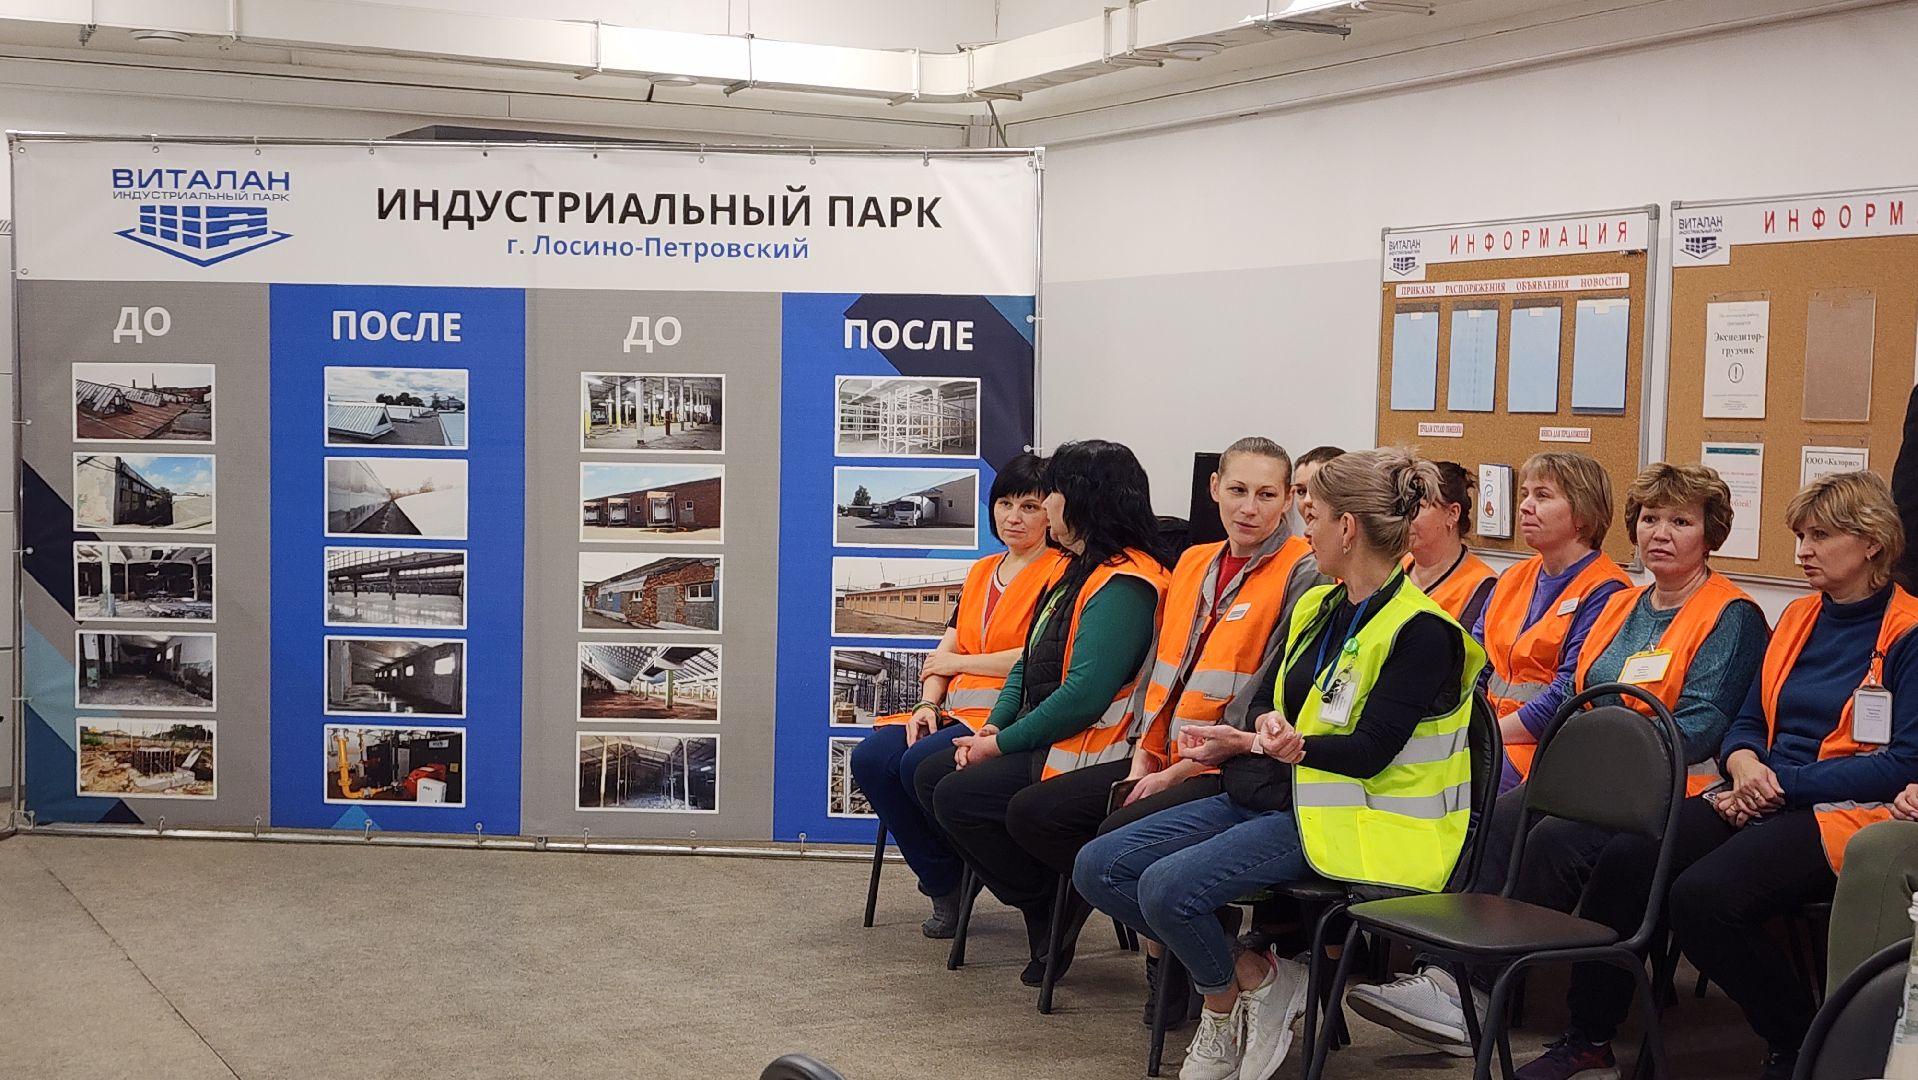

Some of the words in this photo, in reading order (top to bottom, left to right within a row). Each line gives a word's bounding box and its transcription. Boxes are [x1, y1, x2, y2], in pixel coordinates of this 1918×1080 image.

[112, 168, 290, 191] ВИТАЛАН
[112, 190, 248, 201] ИНДУСТРИАЛЬНЫЙ
[252, 193, 290, 202] ПАРК
[376, 185, 811, 230] ИНДУСТРИАЛЬНЫЙ
[828, 196, 942, 228] ПАРК
[1679, 216, 1723, 230] ВИТАЛАН
[1764, 201, 1918, 234] ИНФОРМ
[507, 237, 525, 256] г.
[532, 235, 809, 263] Лосино-Петровский
[1389, 239, 1421, 251] ВИТАЛАН
[1450, 221, 1628, 255] ИНФОРМАЦИЯ
[1401, 285, 1436, 296] ПРИКАЗЫ
[1445, 282, 1506, 294] РАСПОРЯЖЕНИЯ
[1516, 279, 1569, 291] ОБЪЯВЛЕНИЯ
[1580, 276, 1622, 288] НОВОСТИ
[112, 306, 172, 344] ДО
[332, 310, 462, 343] ПОСЛЕ
[622, 316, 682, 353] ДО
[844, 318, 974, 352] ПОСЛЕ
